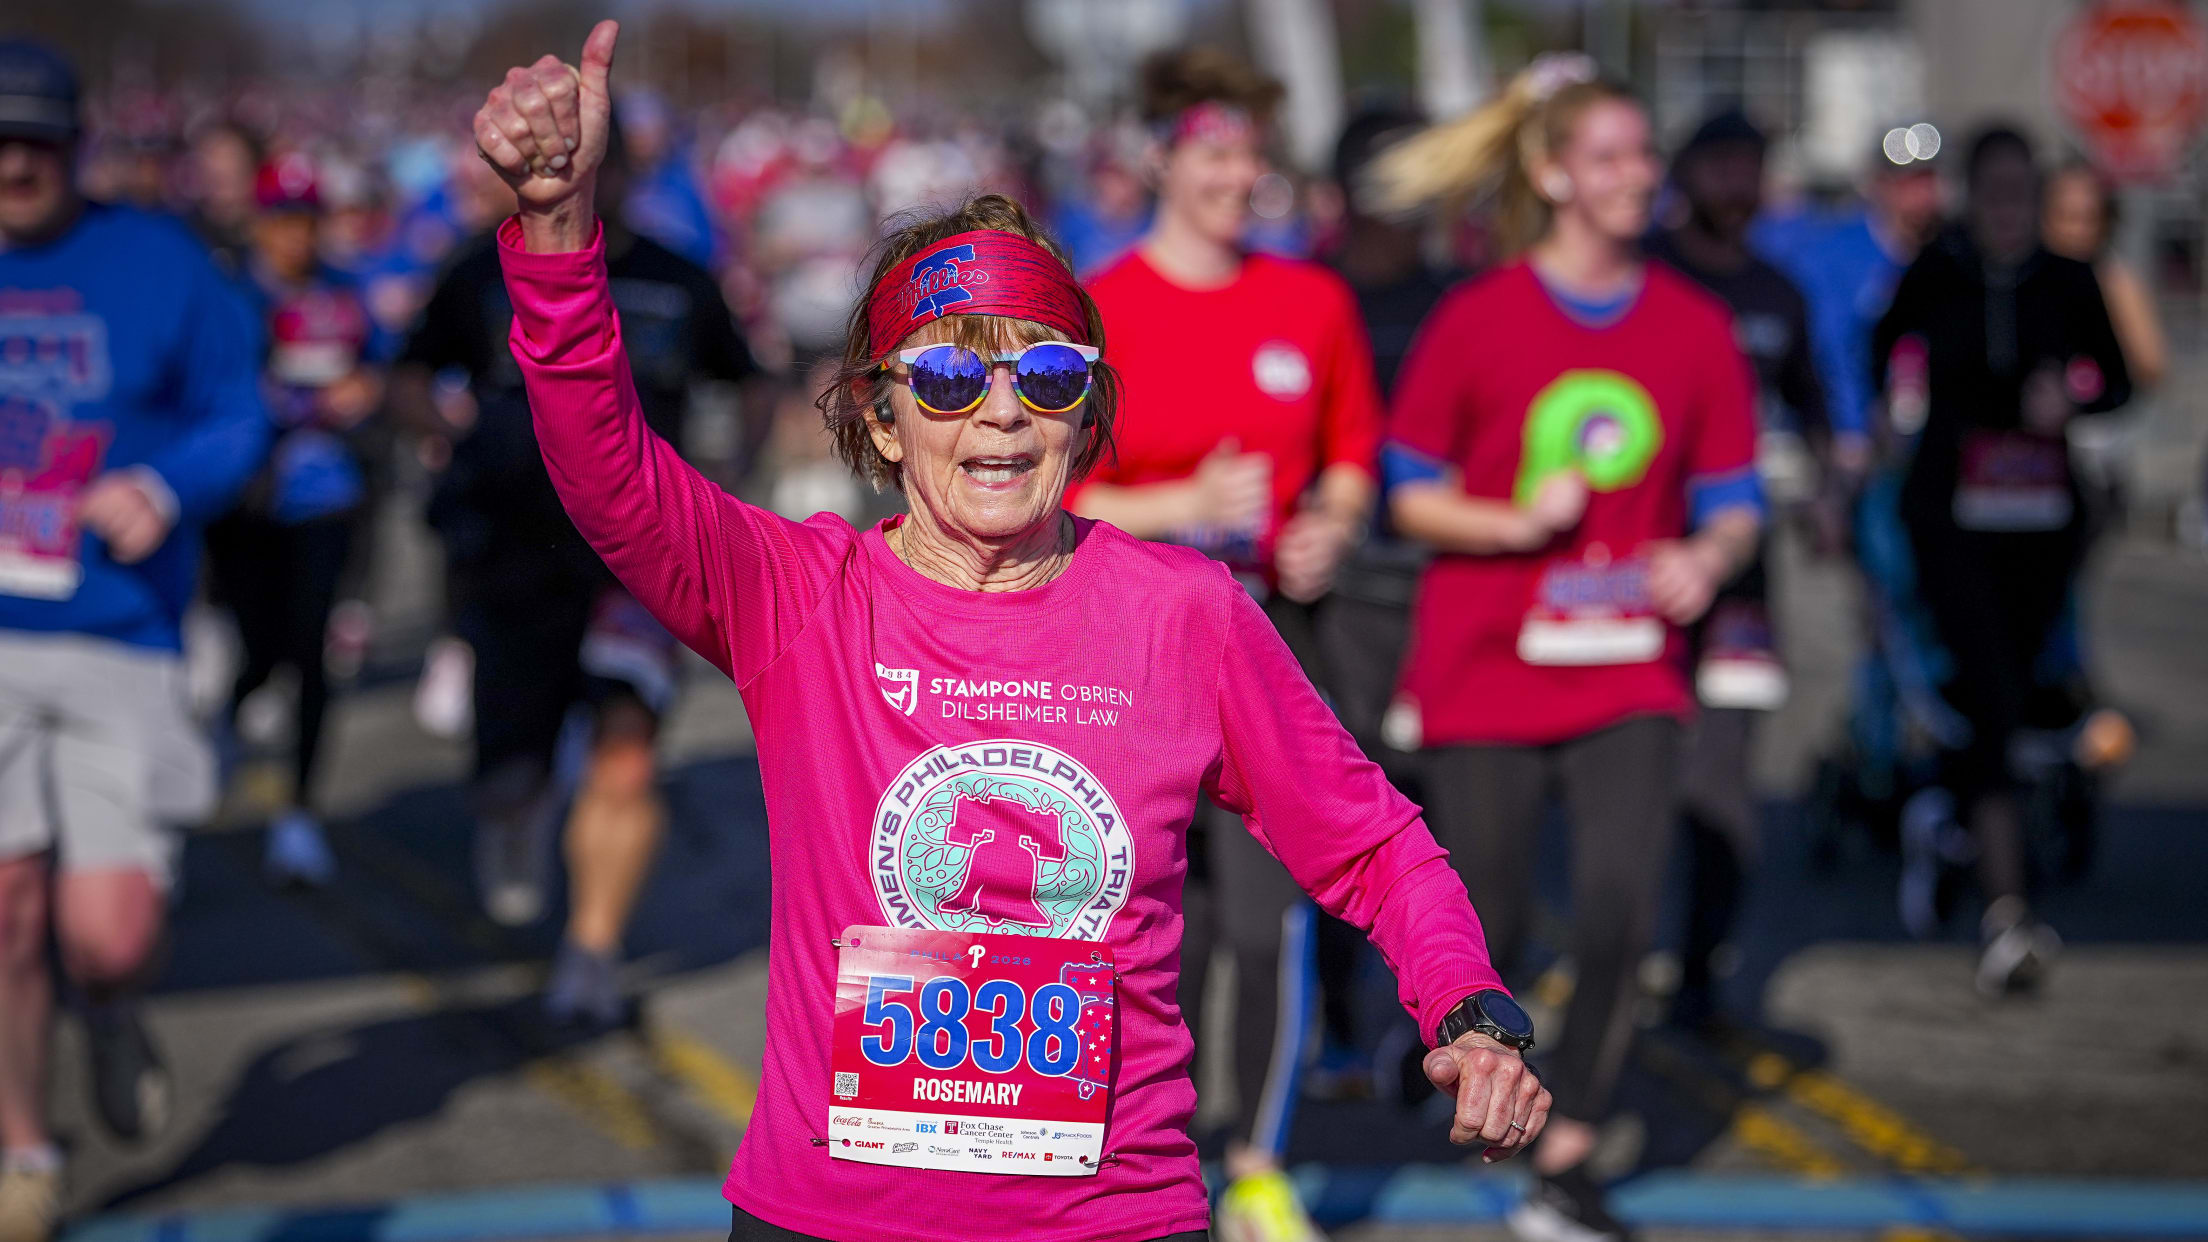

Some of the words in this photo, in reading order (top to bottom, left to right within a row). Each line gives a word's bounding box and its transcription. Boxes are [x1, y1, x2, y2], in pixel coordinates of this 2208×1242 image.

[898, 267, 989, 313] Phillies
[881, 667, 912, 679] 1984
[930, 678, 1052, 699] STAMPONE
[1061, 684, 1133, 707] O'BRIEN
[942, 701, 1067, 724] DILSHEIMER
[1077, 710, 1119, 727] LAW
[895, 748, 1115, 836] PHILADELPHIA
[878, 811, 925, 929] MEN'S
[910, 949, 962, 961] PHILA
[991, 955, 1032, 966] 2026
[860, 974, 1081, 1077] 5838
[912, 1077, 1023, 1106] ROSEMARY
[915, 1123, 938, 1134] IBX
[960, 1121, 976, 1130] Fox
[978, 1122, 1004, 1131] Chase
[959, 1129, 986, 1137] Cancer
[988, 1130, 1014, 1139] Center
[854, 1141, 885, 1150] GIANT
[975, 1138, 994, 1146] Temple
[936, 1146, 960, 1154] NovaCare
[1001, 1151, 1036, 1160] RE/MAX
